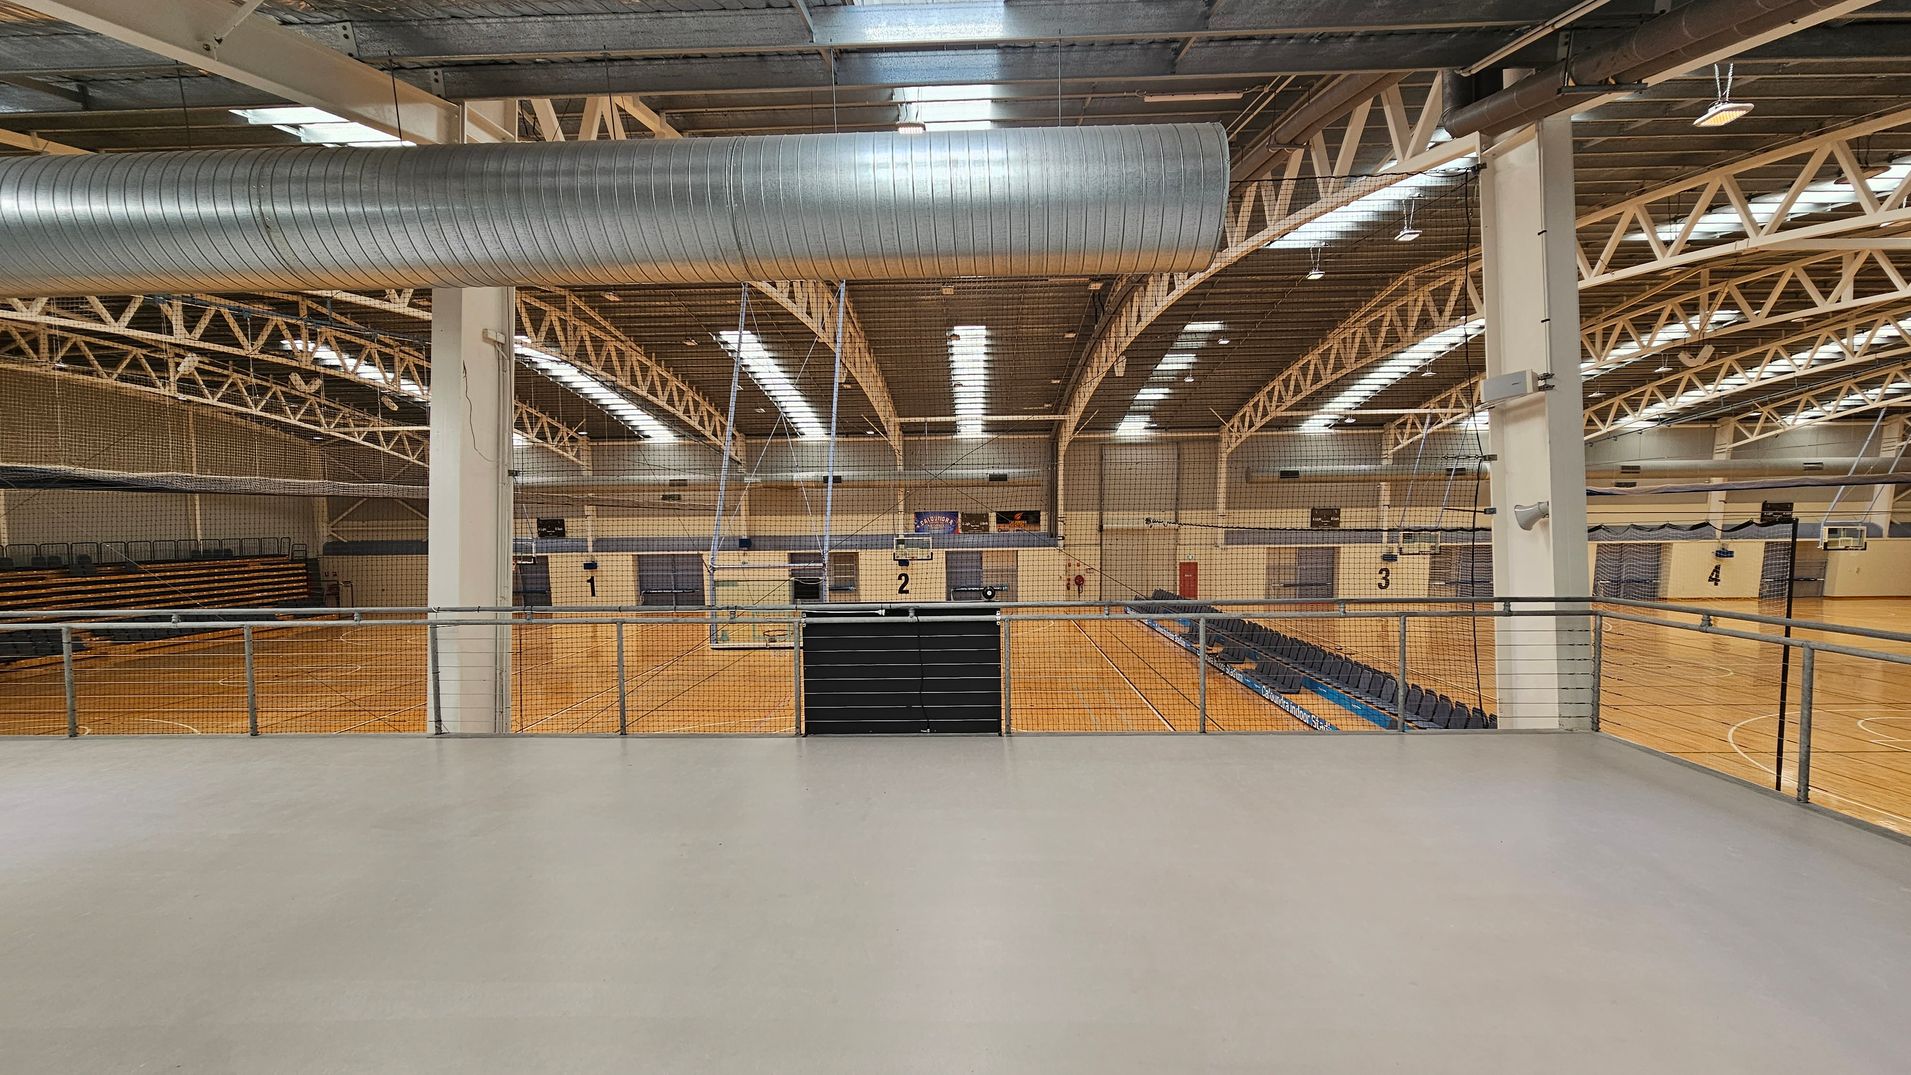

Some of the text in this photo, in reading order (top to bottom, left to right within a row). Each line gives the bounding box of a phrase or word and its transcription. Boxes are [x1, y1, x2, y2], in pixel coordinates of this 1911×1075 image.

[898, 573, 910, 594] 2
[1378, 568, 1390, 589] 3
[1708, 564, 1721, 586] 4
[586, 576, 595, 596] 1
